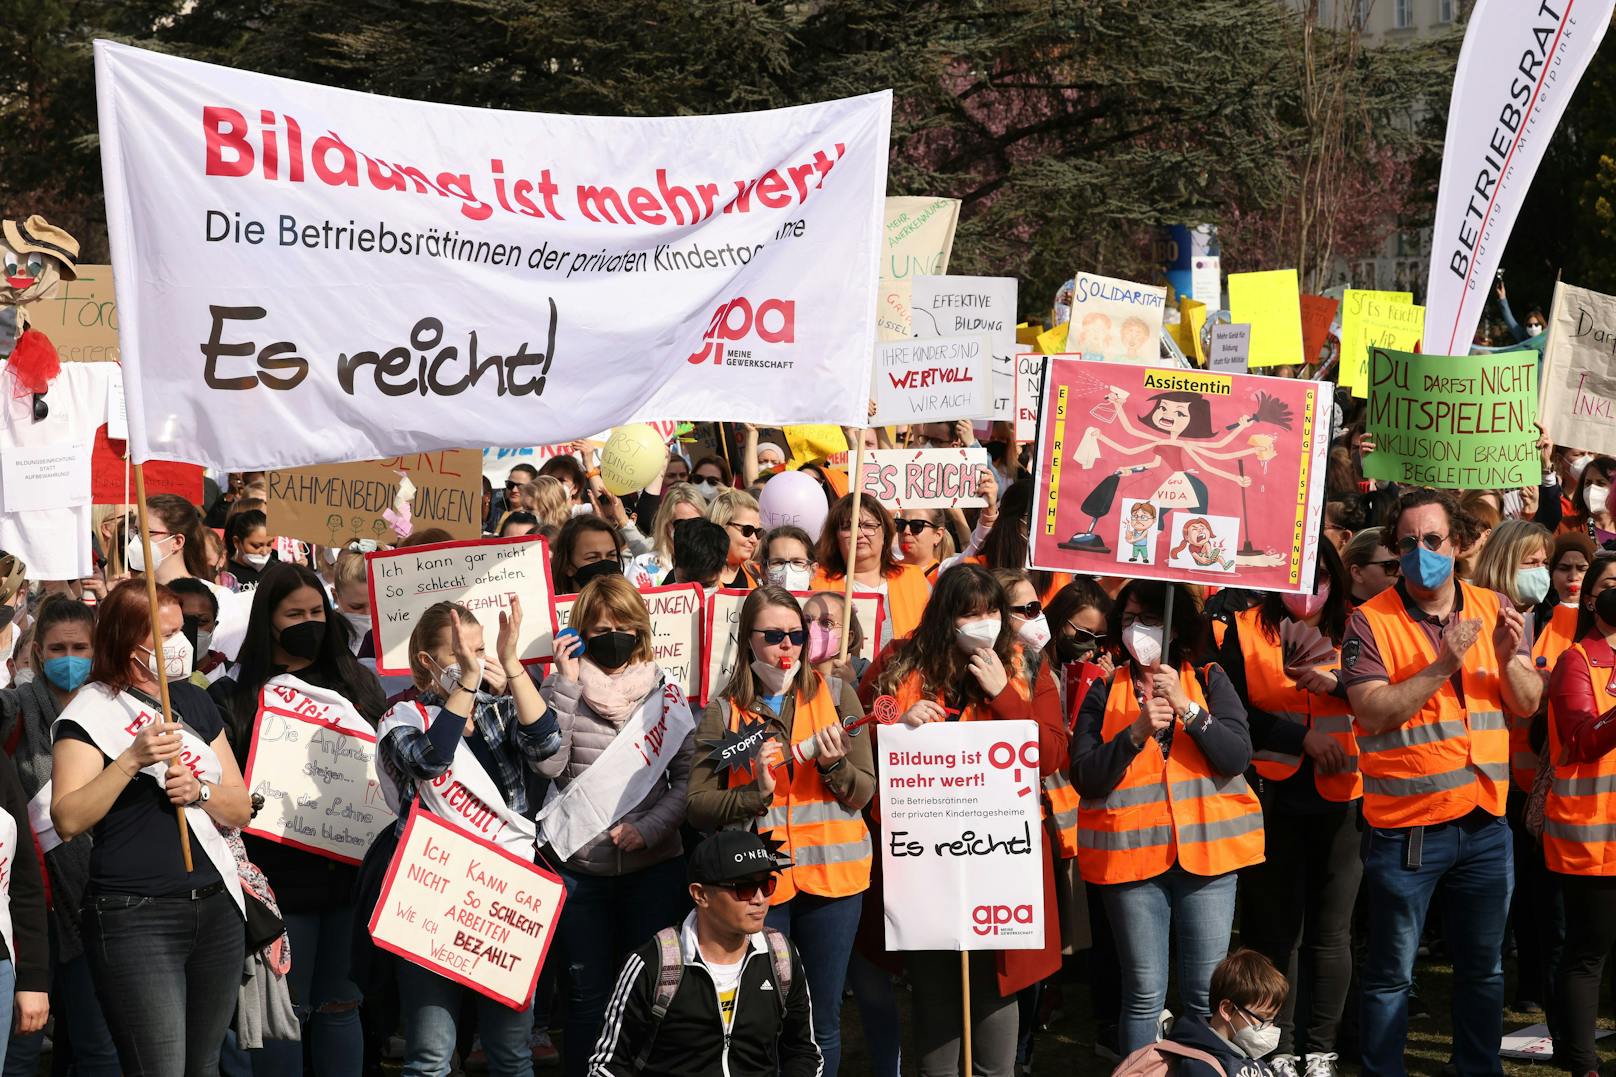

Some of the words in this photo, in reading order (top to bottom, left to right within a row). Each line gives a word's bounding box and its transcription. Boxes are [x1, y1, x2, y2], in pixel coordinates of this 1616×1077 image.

[1450, 0, 1561, 280] BETRIEBSRAT
[1468, 203, 1502, 290] Bildung
[1502, 166, 1515, 189] im
[1516, 17, 1577, 152] Mittelpunkt
[203, 105, 493, 221] Bildung
[490, 158, 566, 221] ist
[577, 168, 720, 226] mehr
[887, 212, 910, 231] MEHR
[206, 210, 265, 246] Die
[279, 213, 521, 268] Betriebsrätinnen
[528, 241, 569, 272] der
[567, 249, 648, 278] privaten
[879, 252, 945, 279] UNG
[932, 294, 992, 310] EFFEKTIVE
[954, 315, 1002, 332] BILDUNG
[201, 305, 309, 391] Es
[337, 297, 557, 398] reicht!
[727, 350, 752, 359] MEINE
[882, 348, 912, 367] IHRE
[911, 346, 950, 363] KINDER
[949, 341, 979, 358] SIND
[1222, 344, 1239, 353] Bildung
[726, 359, 795, 369] GEWERKSCHAFT
[1373, 350, 1409, 390] DU
[1424, 376, 1476, 394] DARFST
[1480, 364, 1534, 395] NICHT
[888, 367, 973, 390] WERTVOLL
[1144, 374, 1231, 395] Assistentin
[908, 396, 935, 413] WIR
[935, 394, 972, 410] AUCH
[1058, 389, 1066, 415] ES
[1303, 392, 1313, 449] GENUG
[1474, 440, 1541, 462] BRAUCHT
[862, 462, 898, 500] ES
[905, 462, 984, 500] REICH
[1046, 440, 1061, 534] REICHT
[1402, 463, 1523, 485] BEGLEITUNG
[1157, 491, 1187, 501] VIDA
[381, 563, 403, 578] Ich
[416, 557, 453, 571] kann
[465, 553, 487, 571] gar
[497, 546, 526, 559] nicht
[1291, 520, 1302, 578] GENUG
[417, 576, 466, 593] schlecht
[475, 569, 526, 585] arbeiten
[259, 715, 299, 742] Die
[721, 729, 764, 760] STOPPT
[889, 752, 957, 769] Bildung
[962, 750, 982, 765] ist
[890, 773, 935, 788] mehr
[940, 772, 985, 788] wert!
[297, 793, 318, 809] die
[891, 797, 905, 805] Die
[907, 796, 978, 805] Betriebsrätinnen
[891, 811, 905, 819] der
[908, 810, 944, 820] privaten
[945, 808, 1025, 820] Kindertagesheime
[890, 831, 924, 857] Es
[935, 820, 1032, 857] reicht!
[422, 837, 451, 866] ICH
[466, 859, 508, 894] KANN
[514, 891, 542, 914] GAR
[407, 863, 450, 894] NICHT
[463, 890, 481, 909] SO
[488, 901, 544, 939] SCHLECHT
[444, 906, 511, 944] ARBEITEN
[972, 904, 1033, 936] gpa
[396, 902, 417, 925] WIE
[421, 918, 439, 935] ICH
[453, 931, 521, 973] BEZAHLT
[430, 938, 480, 975] WERDE!
